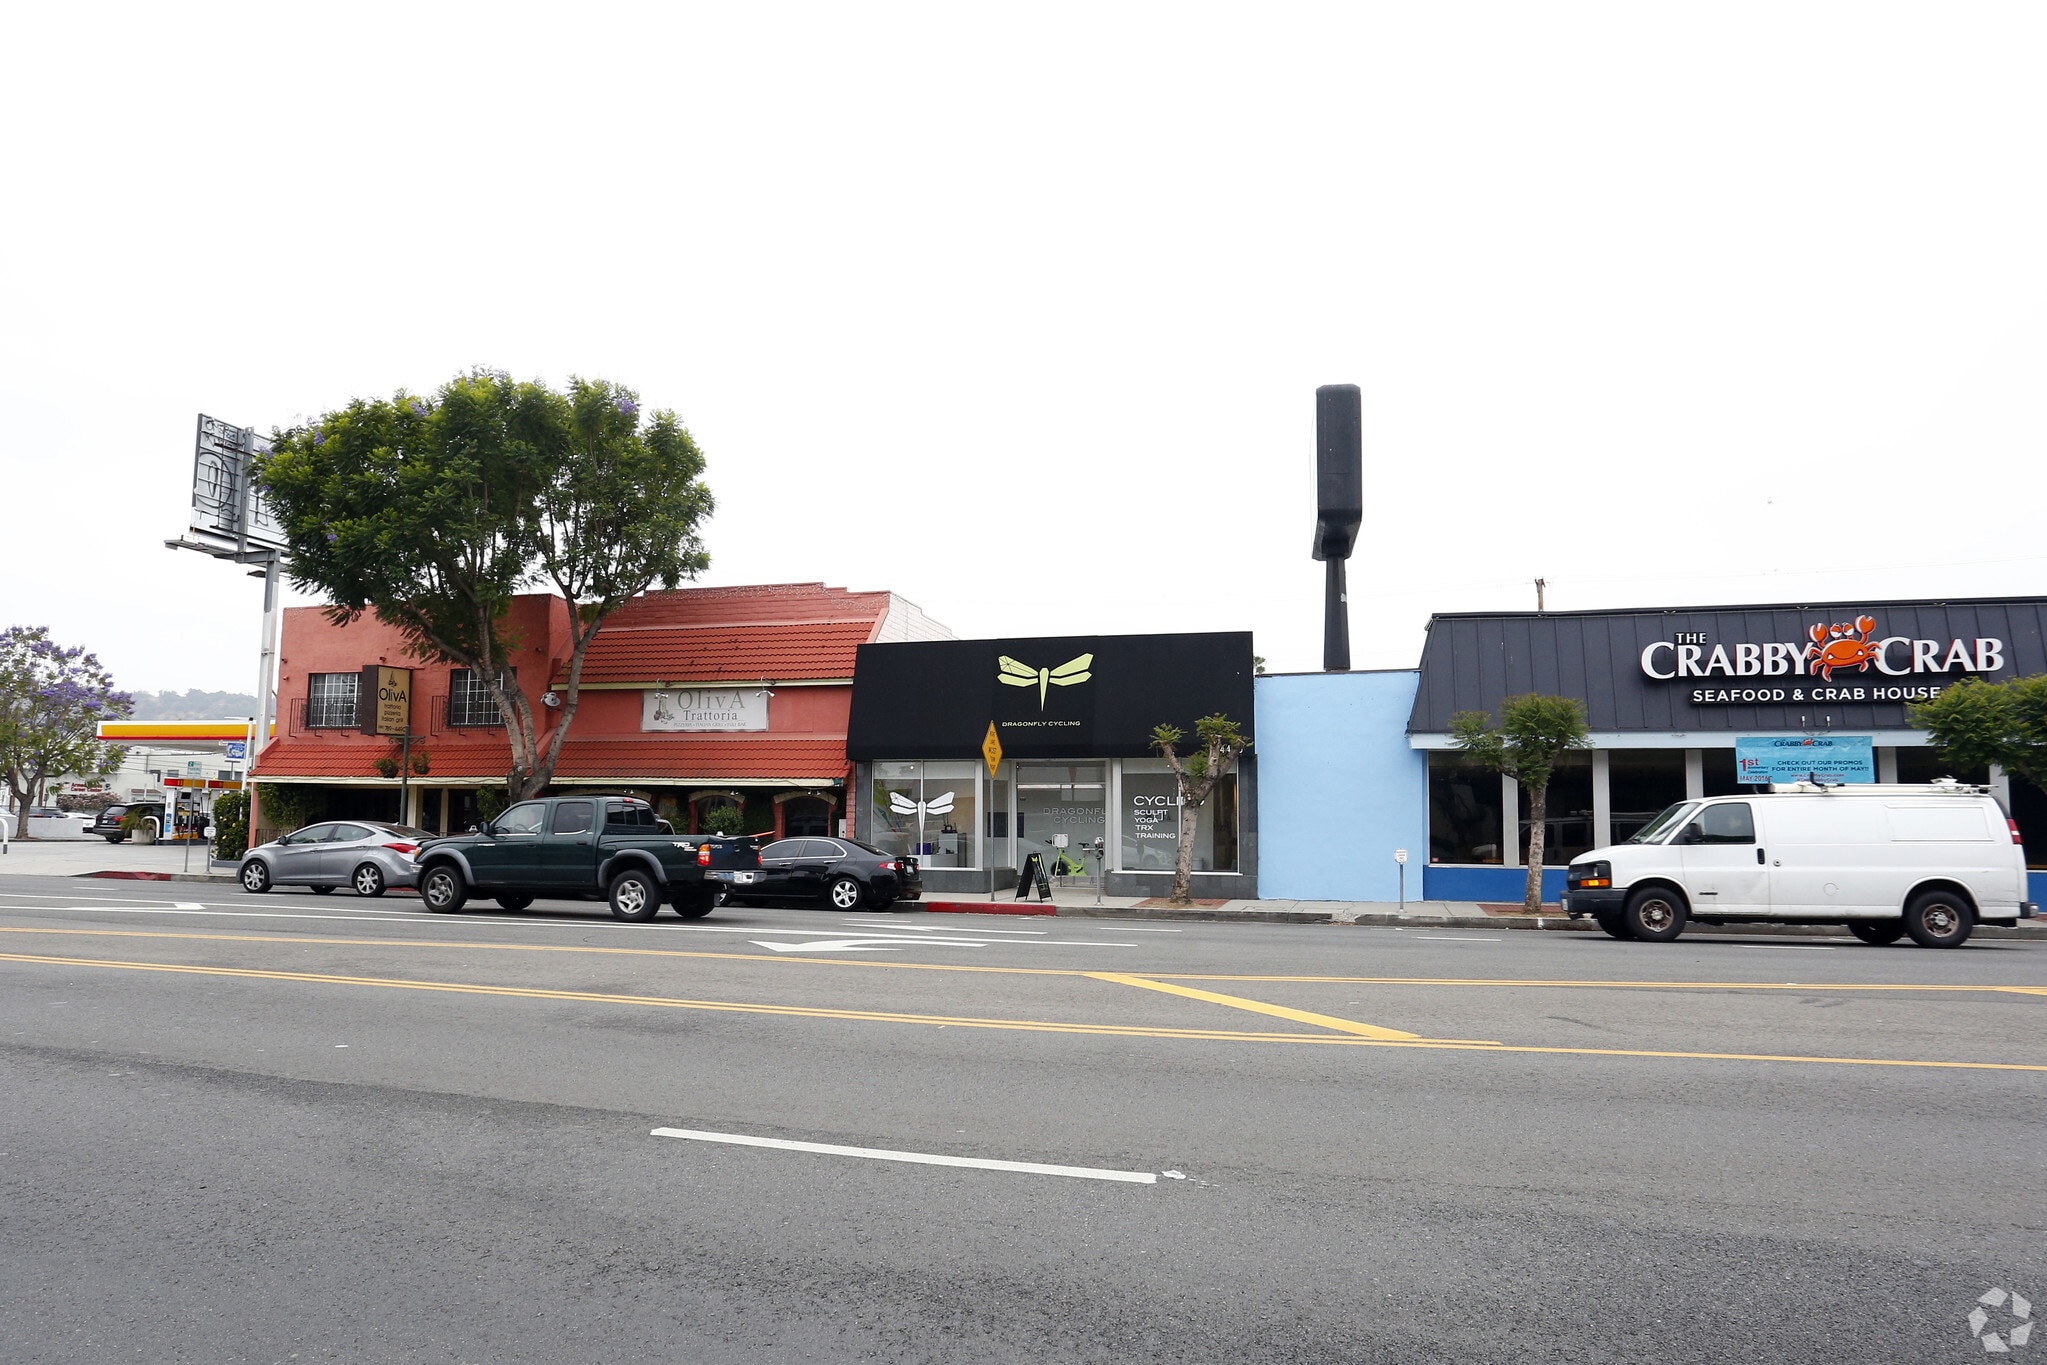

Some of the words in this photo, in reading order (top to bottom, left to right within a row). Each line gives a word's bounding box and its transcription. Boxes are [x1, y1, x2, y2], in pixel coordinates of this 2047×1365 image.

[1676, 632, 1707, 644] THE
[1641, 641, 1814, 680] CRABBY
[1873, 636, 2005, 676] CRAB
[379, 688, 407, 702] OlivA
[677, 690, 745, 709] OlivA
[1692, 689, 1785, 702] SEAFOOD
[1792, 688, 1804, 700] &
[1811, 688, 1866, 700] CRAB
[1873, 686, 1941, 700] HOUSE
[683, 709, 738, 721] Trattoria
[1053, 816, 1106, 824] CYCLING
